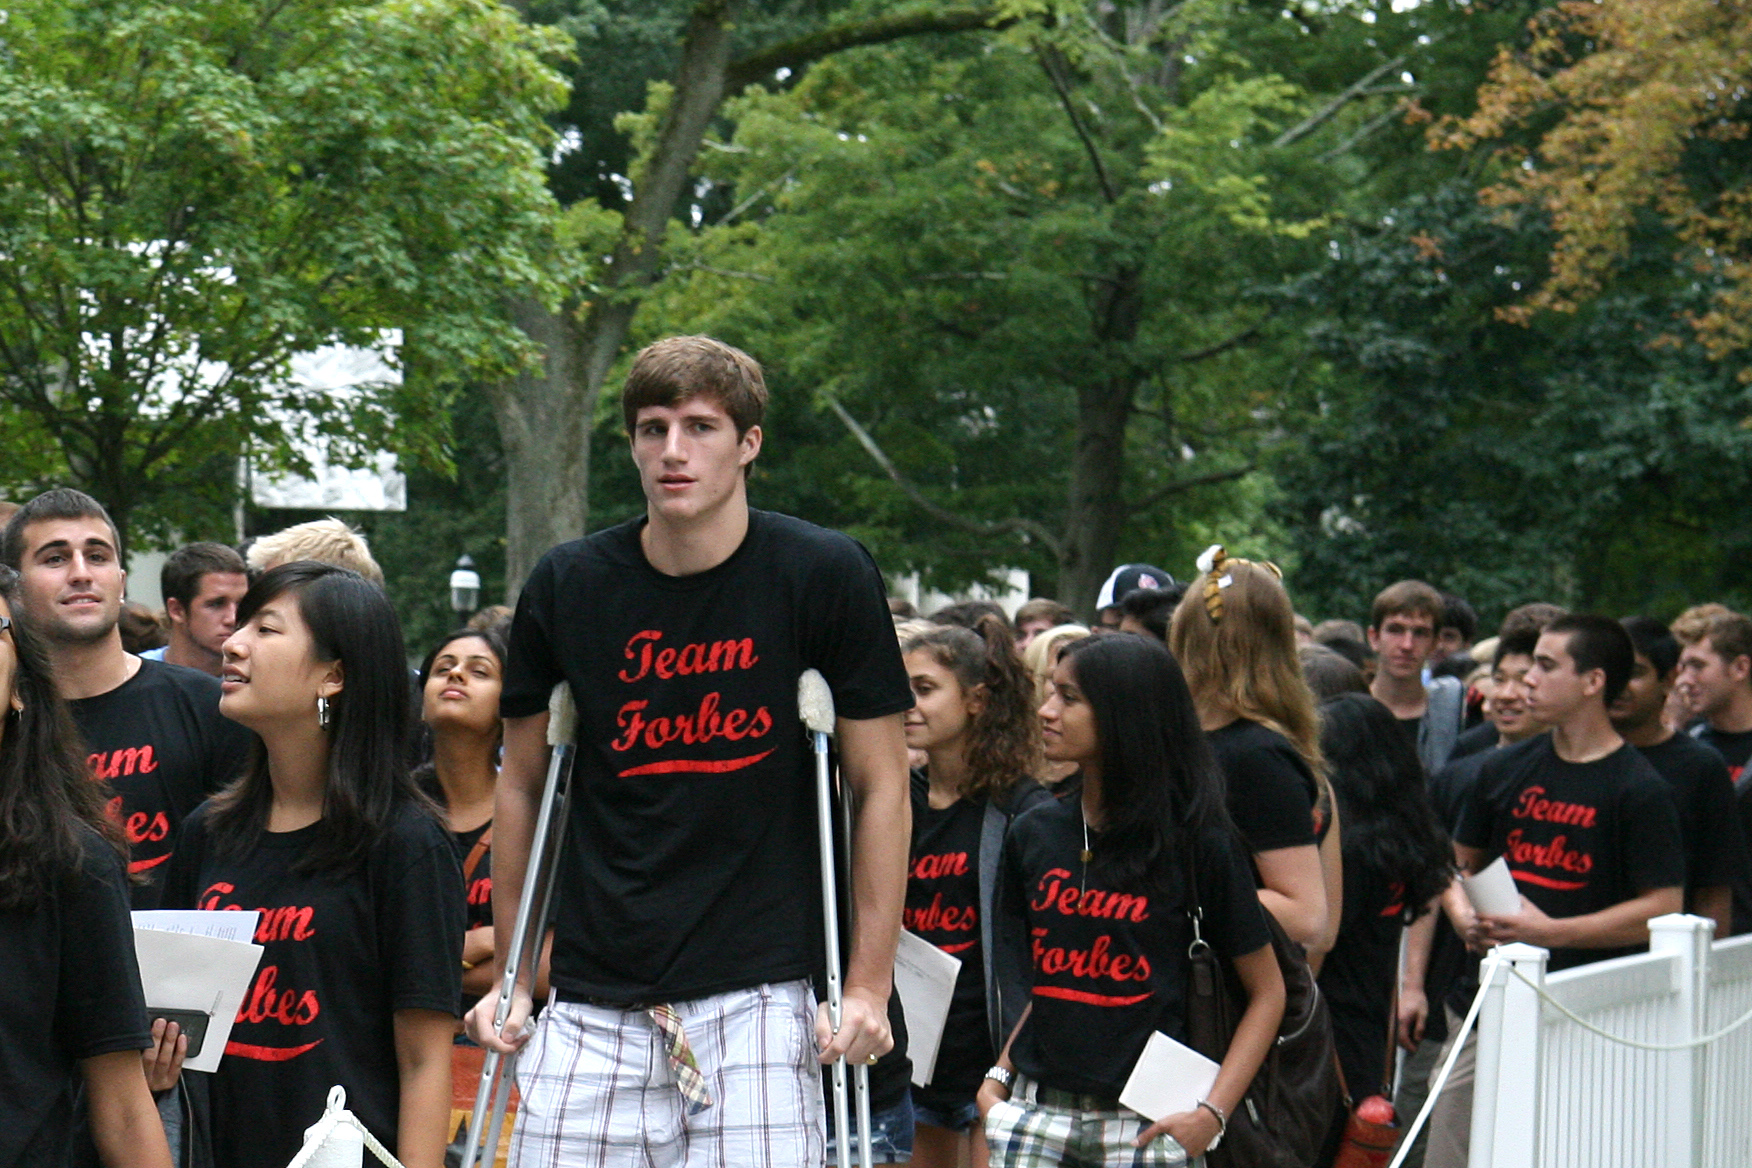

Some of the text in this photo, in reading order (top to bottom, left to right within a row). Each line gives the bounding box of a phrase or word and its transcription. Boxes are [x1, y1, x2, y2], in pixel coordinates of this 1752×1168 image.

[618, 629, 760, 683] Team
[611, 691, 773, 751] Forbes
[1511, 785, 1597, 829] Team
[1503, 828, 1593, 874] Forbes
[903, 892, 977, 931] orbes
[1031, 867, 1150, 923] Team
[1032, 928, 1152, 982] Forbes
